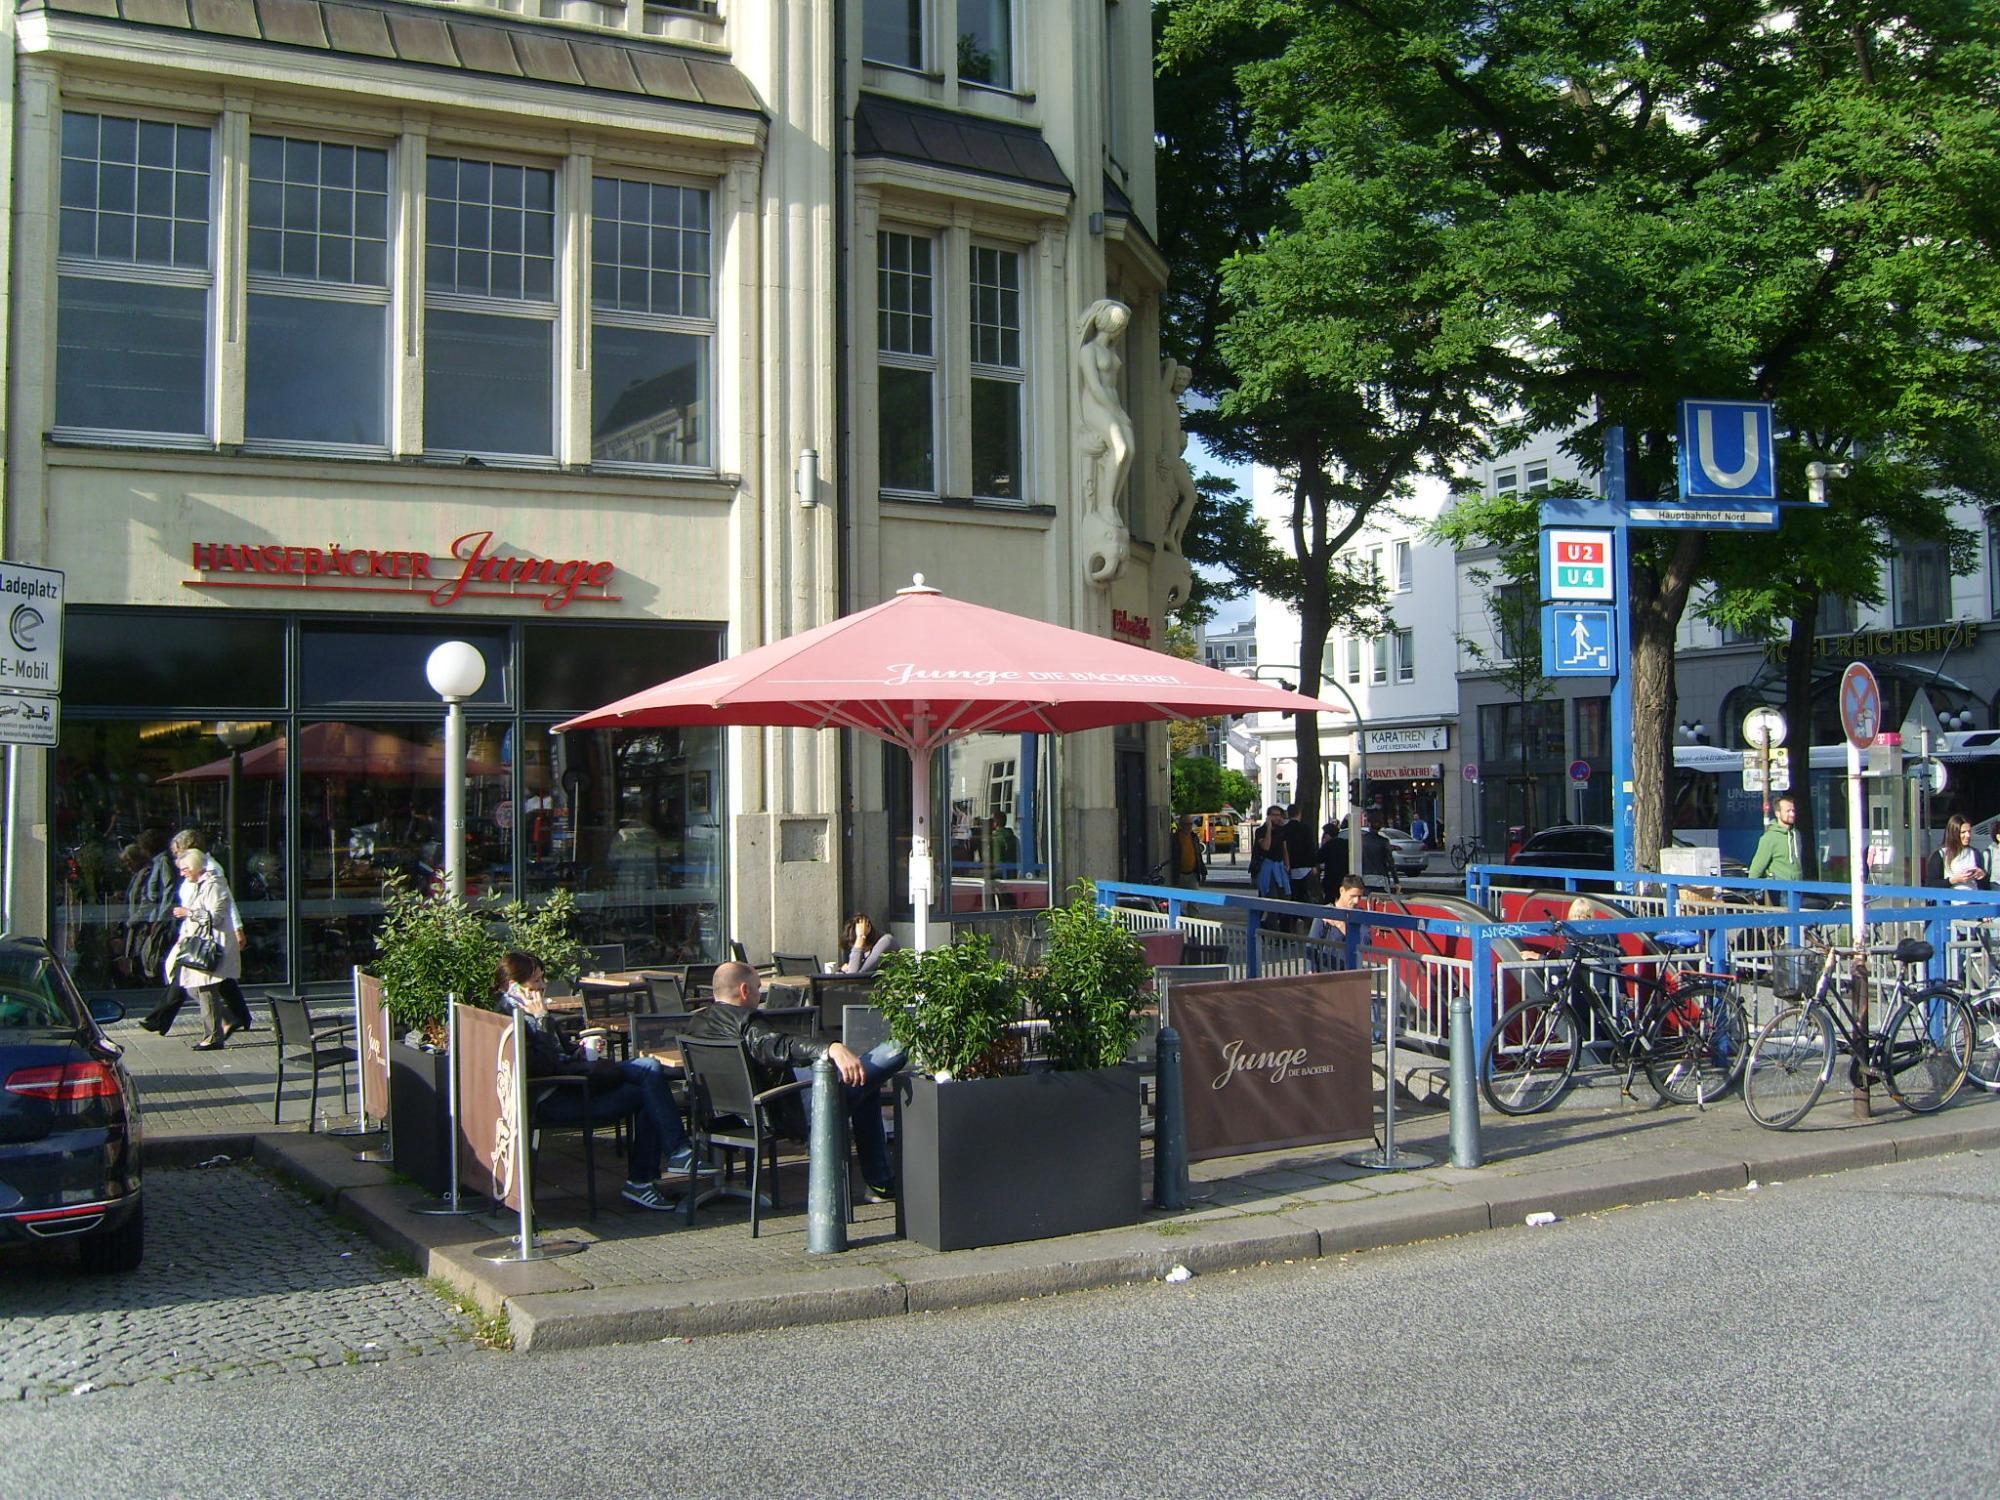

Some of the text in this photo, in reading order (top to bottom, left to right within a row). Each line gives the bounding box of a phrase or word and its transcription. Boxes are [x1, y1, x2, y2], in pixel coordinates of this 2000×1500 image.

[1697, 409, 1759, 489] U
[1658, 511, 1746, 522] Hauptbahnhof Nord
[192, 530, 616, 611] HANSEBÄCKER Junge
[0, 574, 58, 601] Ladeplatz
[1837, 623, 1978, 658] REICHSHOF
[0, 657, 49, 680] E-Mobil
[884, 663, 1023, 686] Junge
[1028, 671, 1069, 681] DIE
[1371, 730, 1426, 744] KARATREN
[1212, 1039, 1308, 1090] Junge
[1289, 1069, 1300, 1077] DIE
